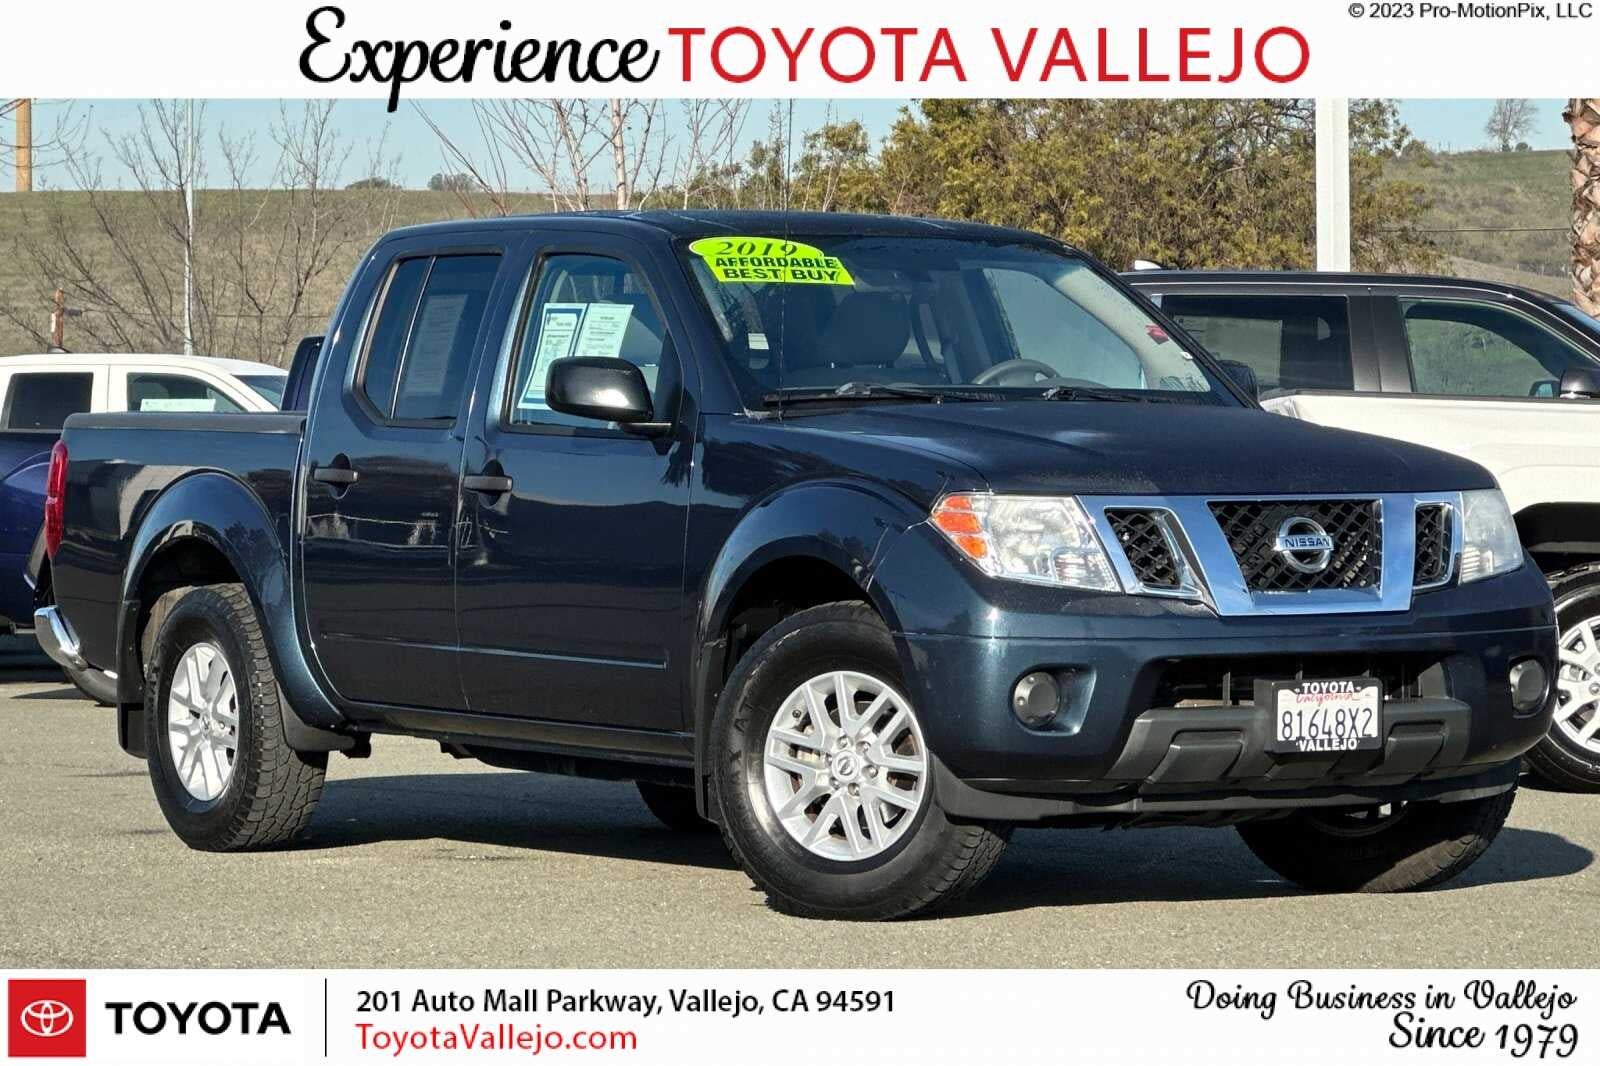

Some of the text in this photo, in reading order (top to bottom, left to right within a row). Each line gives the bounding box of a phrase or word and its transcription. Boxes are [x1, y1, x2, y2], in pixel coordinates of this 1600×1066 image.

[716, 240, 798, 256] 2019
[715, 257, 837, 269] AFFORDABLE
[723, 268, 841, 282] BEST BUY
[1284, 537, 1331, 548] NISSAN
[1301, 681, 1355, 694] TOYOTA
[1281, 707, 1373, 741] 81648X2
[1299, 739, 1358, 751] VALLEJO
